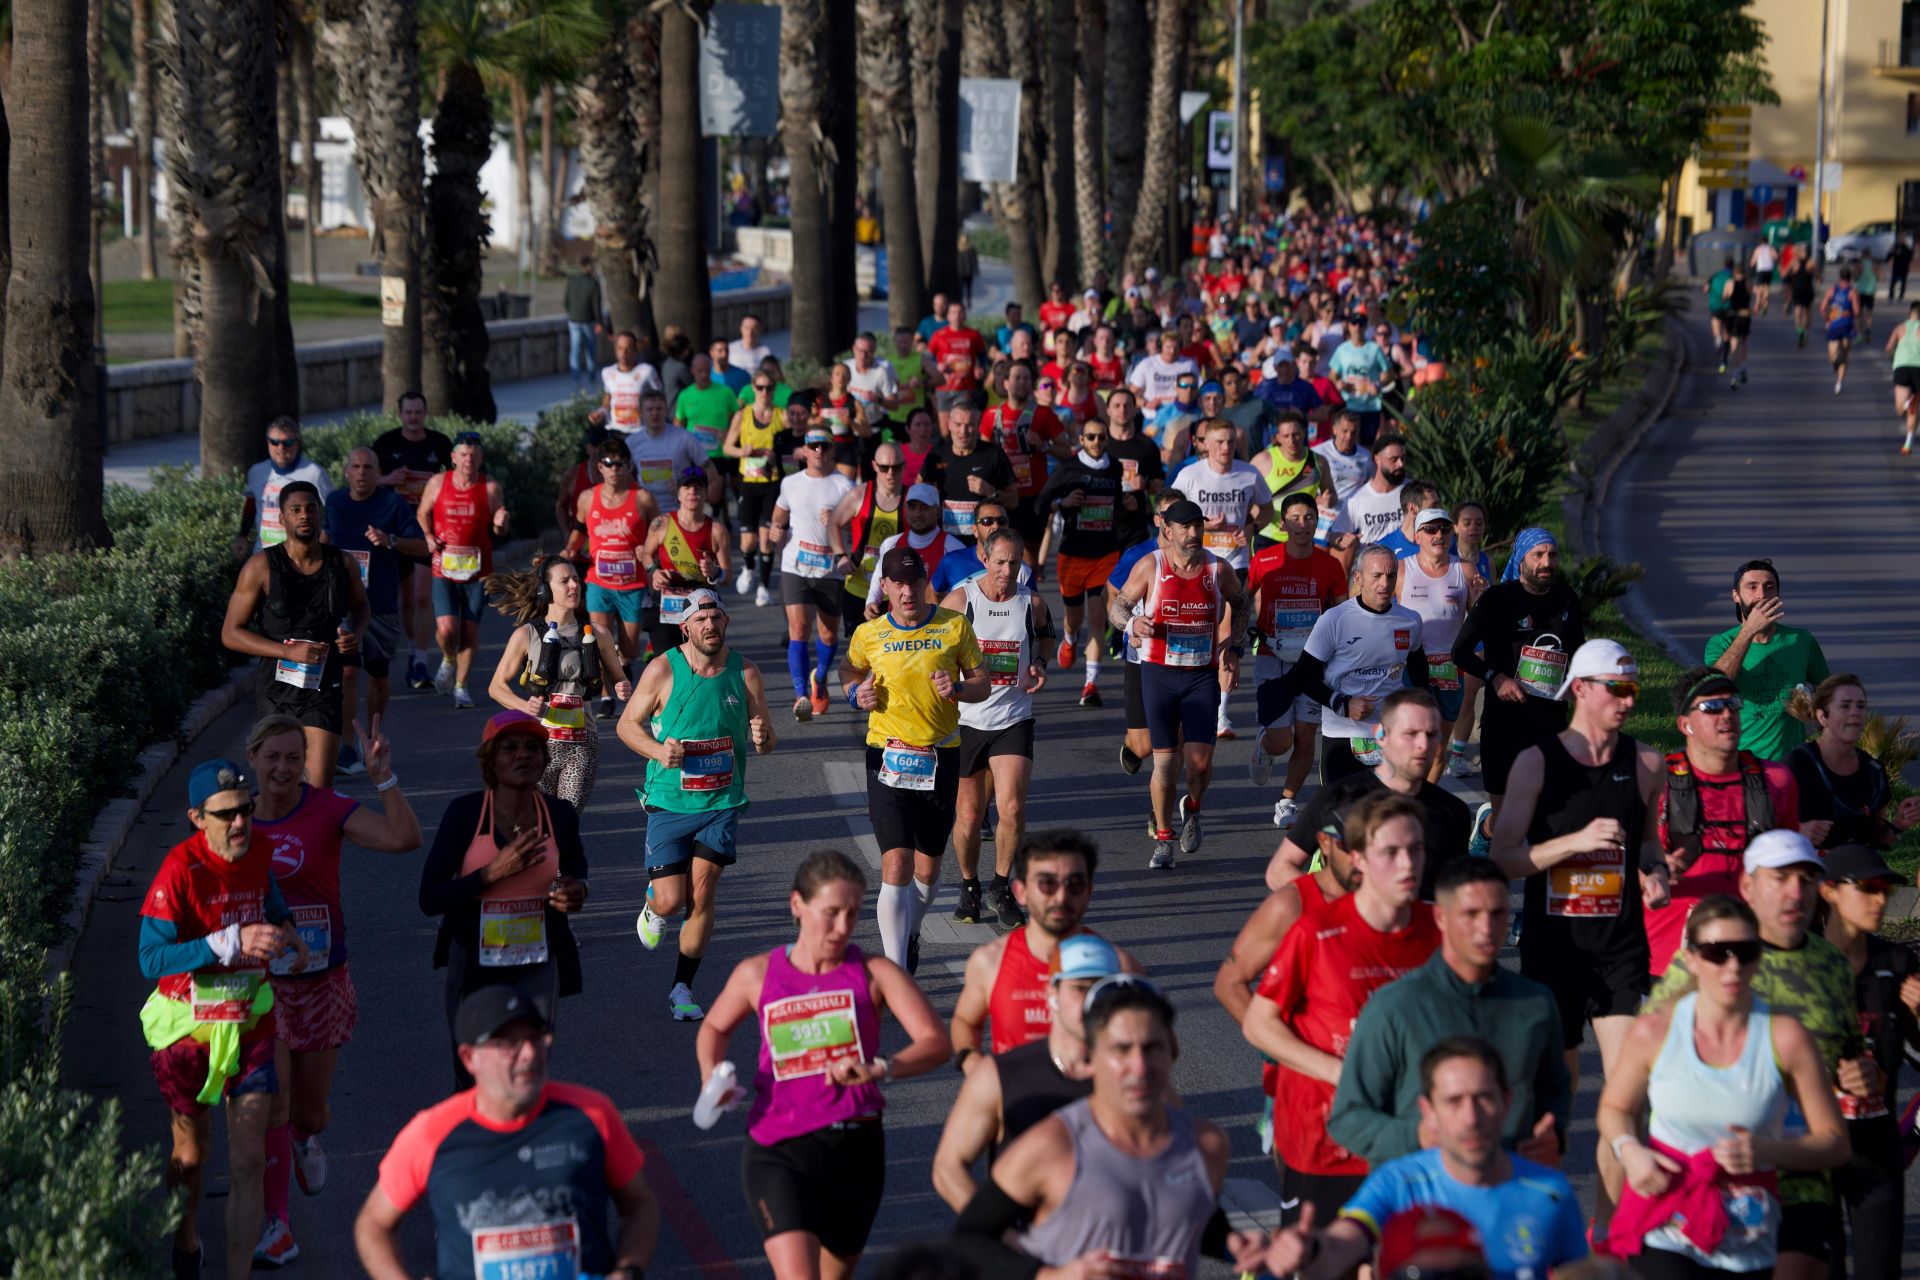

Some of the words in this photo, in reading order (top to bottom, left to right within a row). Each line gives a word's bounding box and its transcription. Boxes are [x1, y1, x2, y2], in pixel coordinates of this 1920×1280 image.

[1199, 489, 1245, 502] CrossFit
[1364, 509, 1403, 525] CrossF
[1285, 614, 1312, 622] 15234
[884, 639, 942, 652] SWEDEN
[698, 757, 722, 767] 1998
[893, 755, 925, 768] 16042
